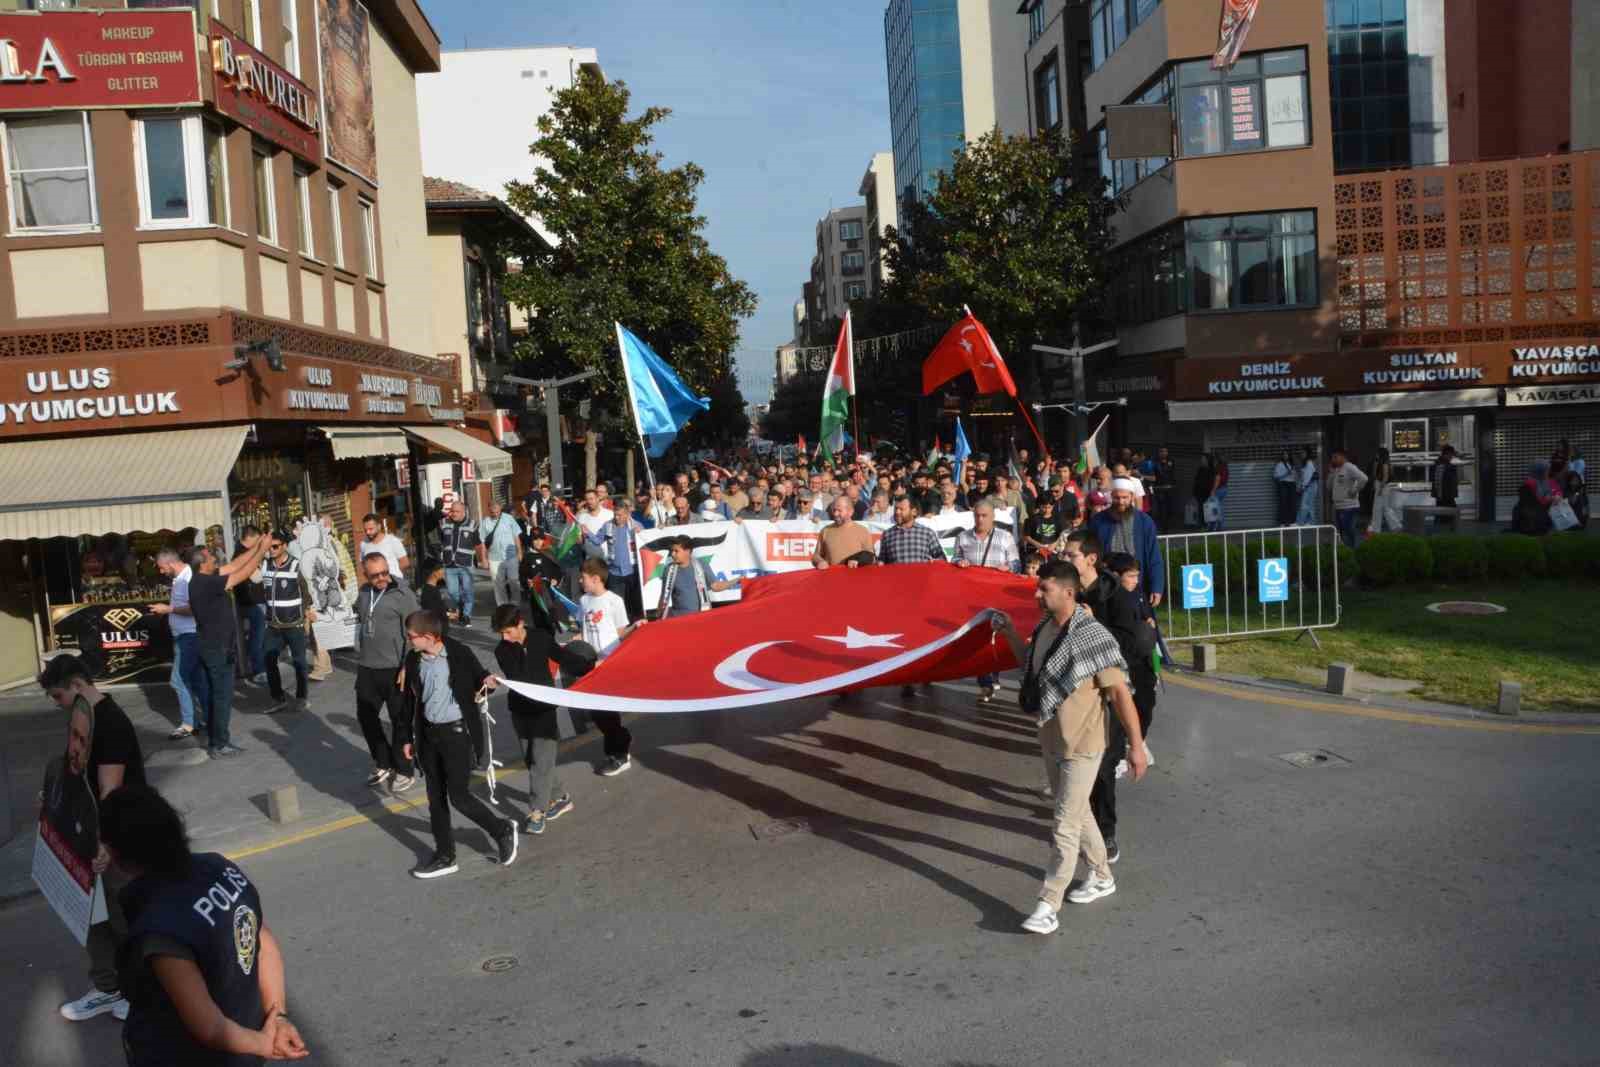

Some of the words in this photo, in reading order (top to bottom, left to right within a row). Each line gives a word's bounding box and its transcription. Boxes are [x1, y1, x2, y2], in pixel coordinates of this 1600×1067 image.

[102, 27, 155, 41] MAKEUP
[78, 52, 127, 67] TÜRBAN
[130, 51, 184, 65] TASARIM
[1390, 351, 1459, 367] SULTAN
[306, 367, 333, 386] ULUS
[1241, 360, 1292, 377] DENİZ
[1363, 367, 1484, 384] KUYUMCULUK
[27, 367, 111, 393] ULUS
[1208, 376, 1326, 394] KUYUMCULUK
[287, 390, 351, 411] KUYUMCULUK
[100, 630, 150, 642] ULUS
[193, 867, 247, 927] POLİS
